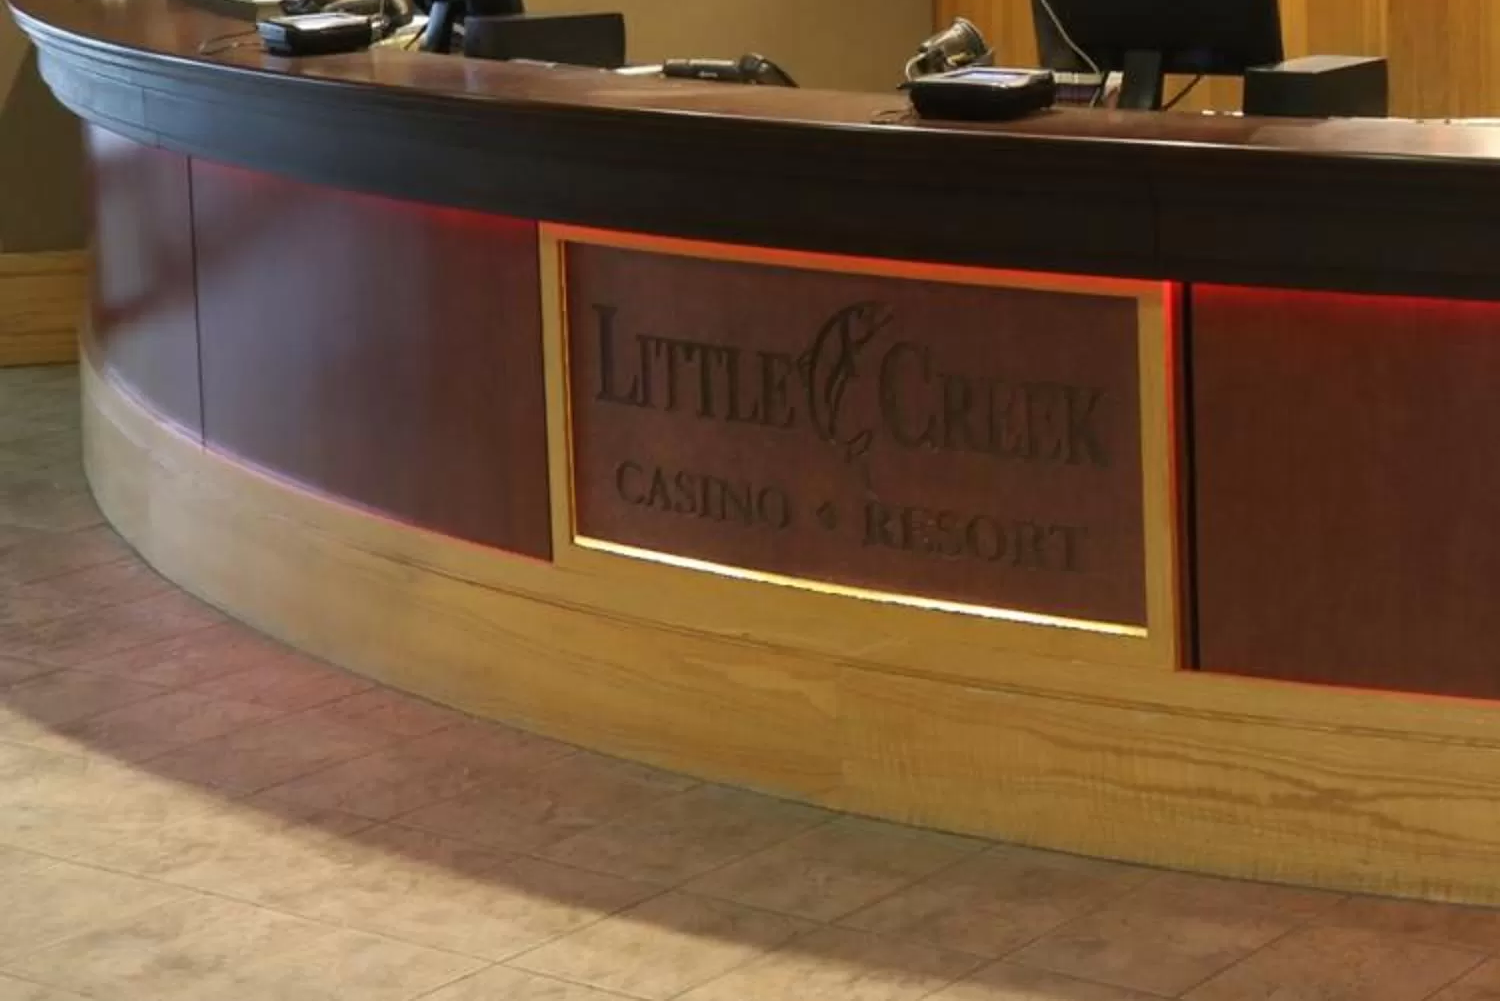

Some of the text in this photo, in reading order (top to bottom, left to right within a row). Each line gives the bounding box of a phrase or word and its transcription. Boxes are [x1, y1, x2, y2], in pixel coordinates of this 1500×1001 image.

[591, 303, 1110, 468] LITTLE CREEK
[614, 460, 1090, 572] CASINO RESORT
